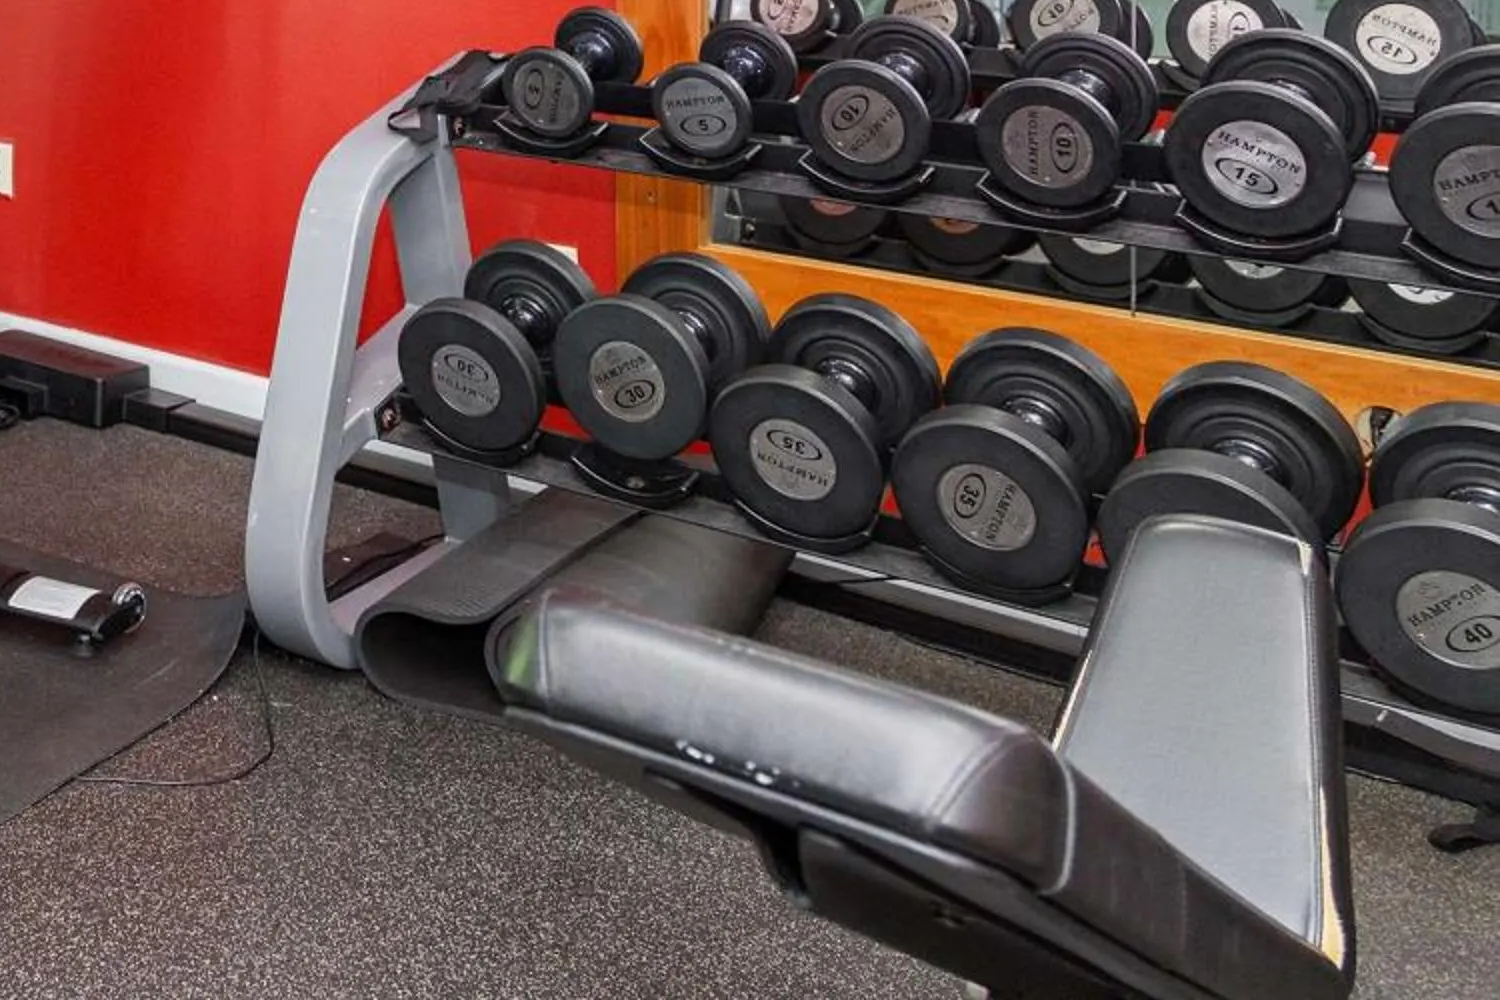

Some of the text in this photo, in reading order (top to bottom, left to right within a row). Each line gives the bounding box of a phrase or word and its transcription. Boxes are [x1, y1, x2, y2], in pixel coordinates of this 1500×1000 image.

[665, 95, 725, 110] HAMPTON
[840, 103, 860, 122] 10
[698, 118, 709, 131] 5
[1027, 110, 1040, 177] HAMPTON
[1056, 137, 1072, 157] 10
[1218, 130, 1302, 174] HAMPTON
[1235, 167, 1261, 187] 15
[593, 355, 647, 385] HAMPTON
[624, 385, 646, 403] 30
[782, 435, 805, 455] 35
[757, 451, 828, 488] HAMPTON
[960, 484, 980, 508] 35
[985, 482, 1016, 542] HAMPTON
[1464, 623, 1493, 643] 40
